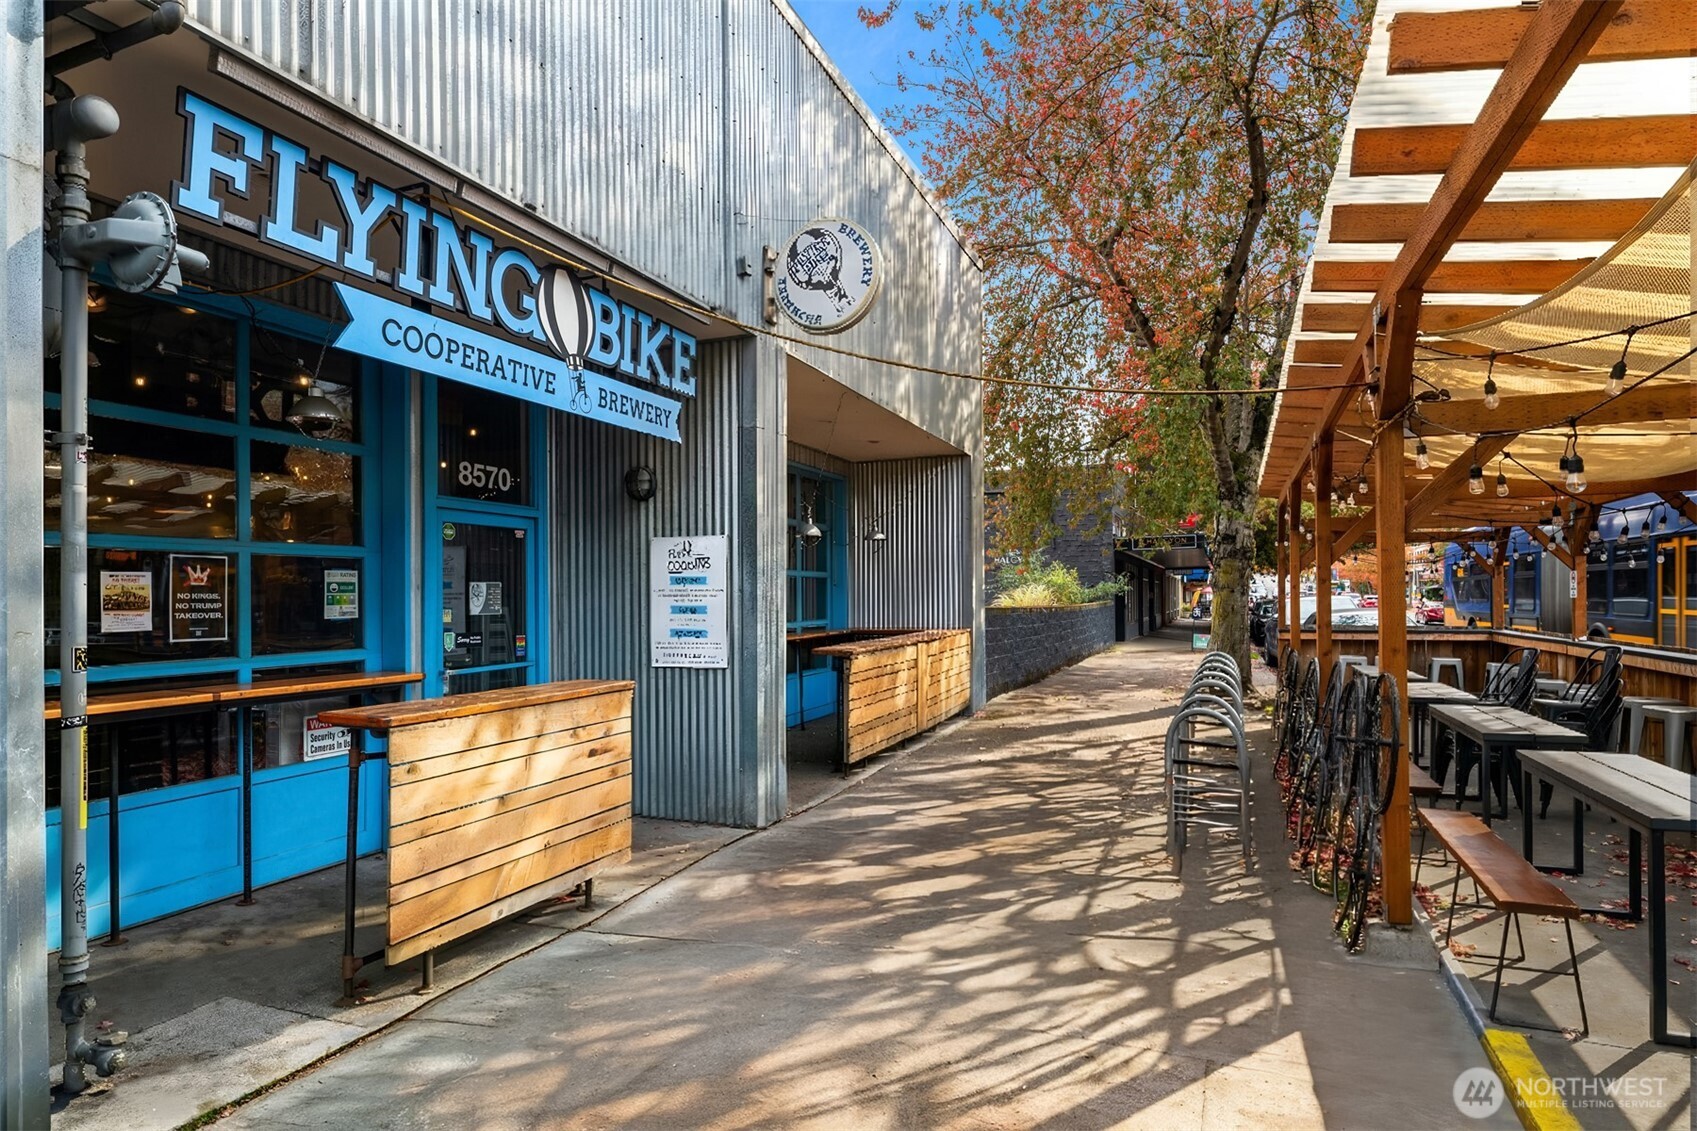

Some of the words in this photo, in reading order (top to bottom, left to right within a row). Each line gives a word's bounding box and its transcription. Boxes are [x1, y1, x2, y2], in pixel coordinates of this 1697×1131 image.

[173, 89, 542, 340] FLYING
[589, 289, 697, 396] BIKE
[838, 222, 873, 287] BREWERY
[381, 318, 557, 396] COOPERATIVE
[597, 386, 672, 430] BREWERY
[458, 461, 512, 491] 8570
[310, 731, 335, 743] Security
[310, 743, 335, 754] Cameras
[336, 741, 342, 749] In
[343, 739, 351, 748] Us
